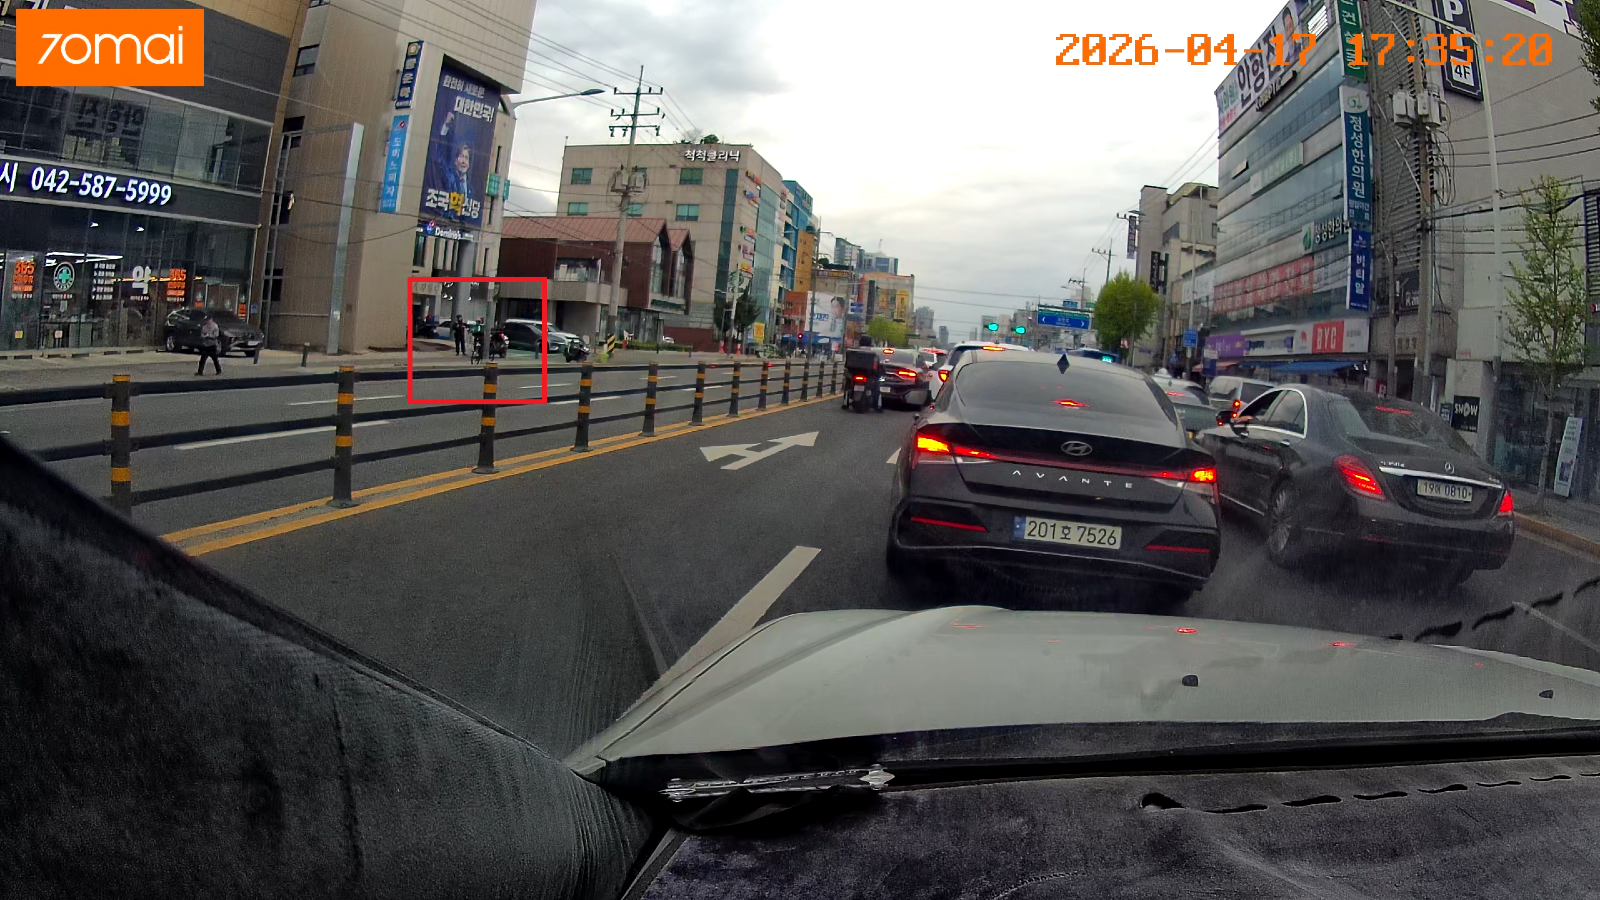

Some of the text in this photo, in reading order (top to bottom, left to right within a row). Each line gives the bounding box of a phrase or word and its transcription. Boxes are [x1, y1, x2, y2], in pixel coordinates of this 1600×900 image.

[1454, 65, 1471, 80] 4F
[454, 96, 495, 123] 대한민국!
[386, 137, 401, 197] 도미노피자
[685, 149, 740, 162] 척척클리닉
[1350, 115, 1366, 198] 정성한의원
[31, 166, 172, 206] 042-587-5999
[425, 188, 480, 219] 조국혁신당
[434, 226, 461, 240] Domino's
[131, 265, 151, 294] 약
[1316, 326, 1337, 350] BYC
[1012, 470, 1133, 489] AVANTE
[1444, 485, 1468, 500] 0810
[1026, 520, 1118, 546] 201호 7526
